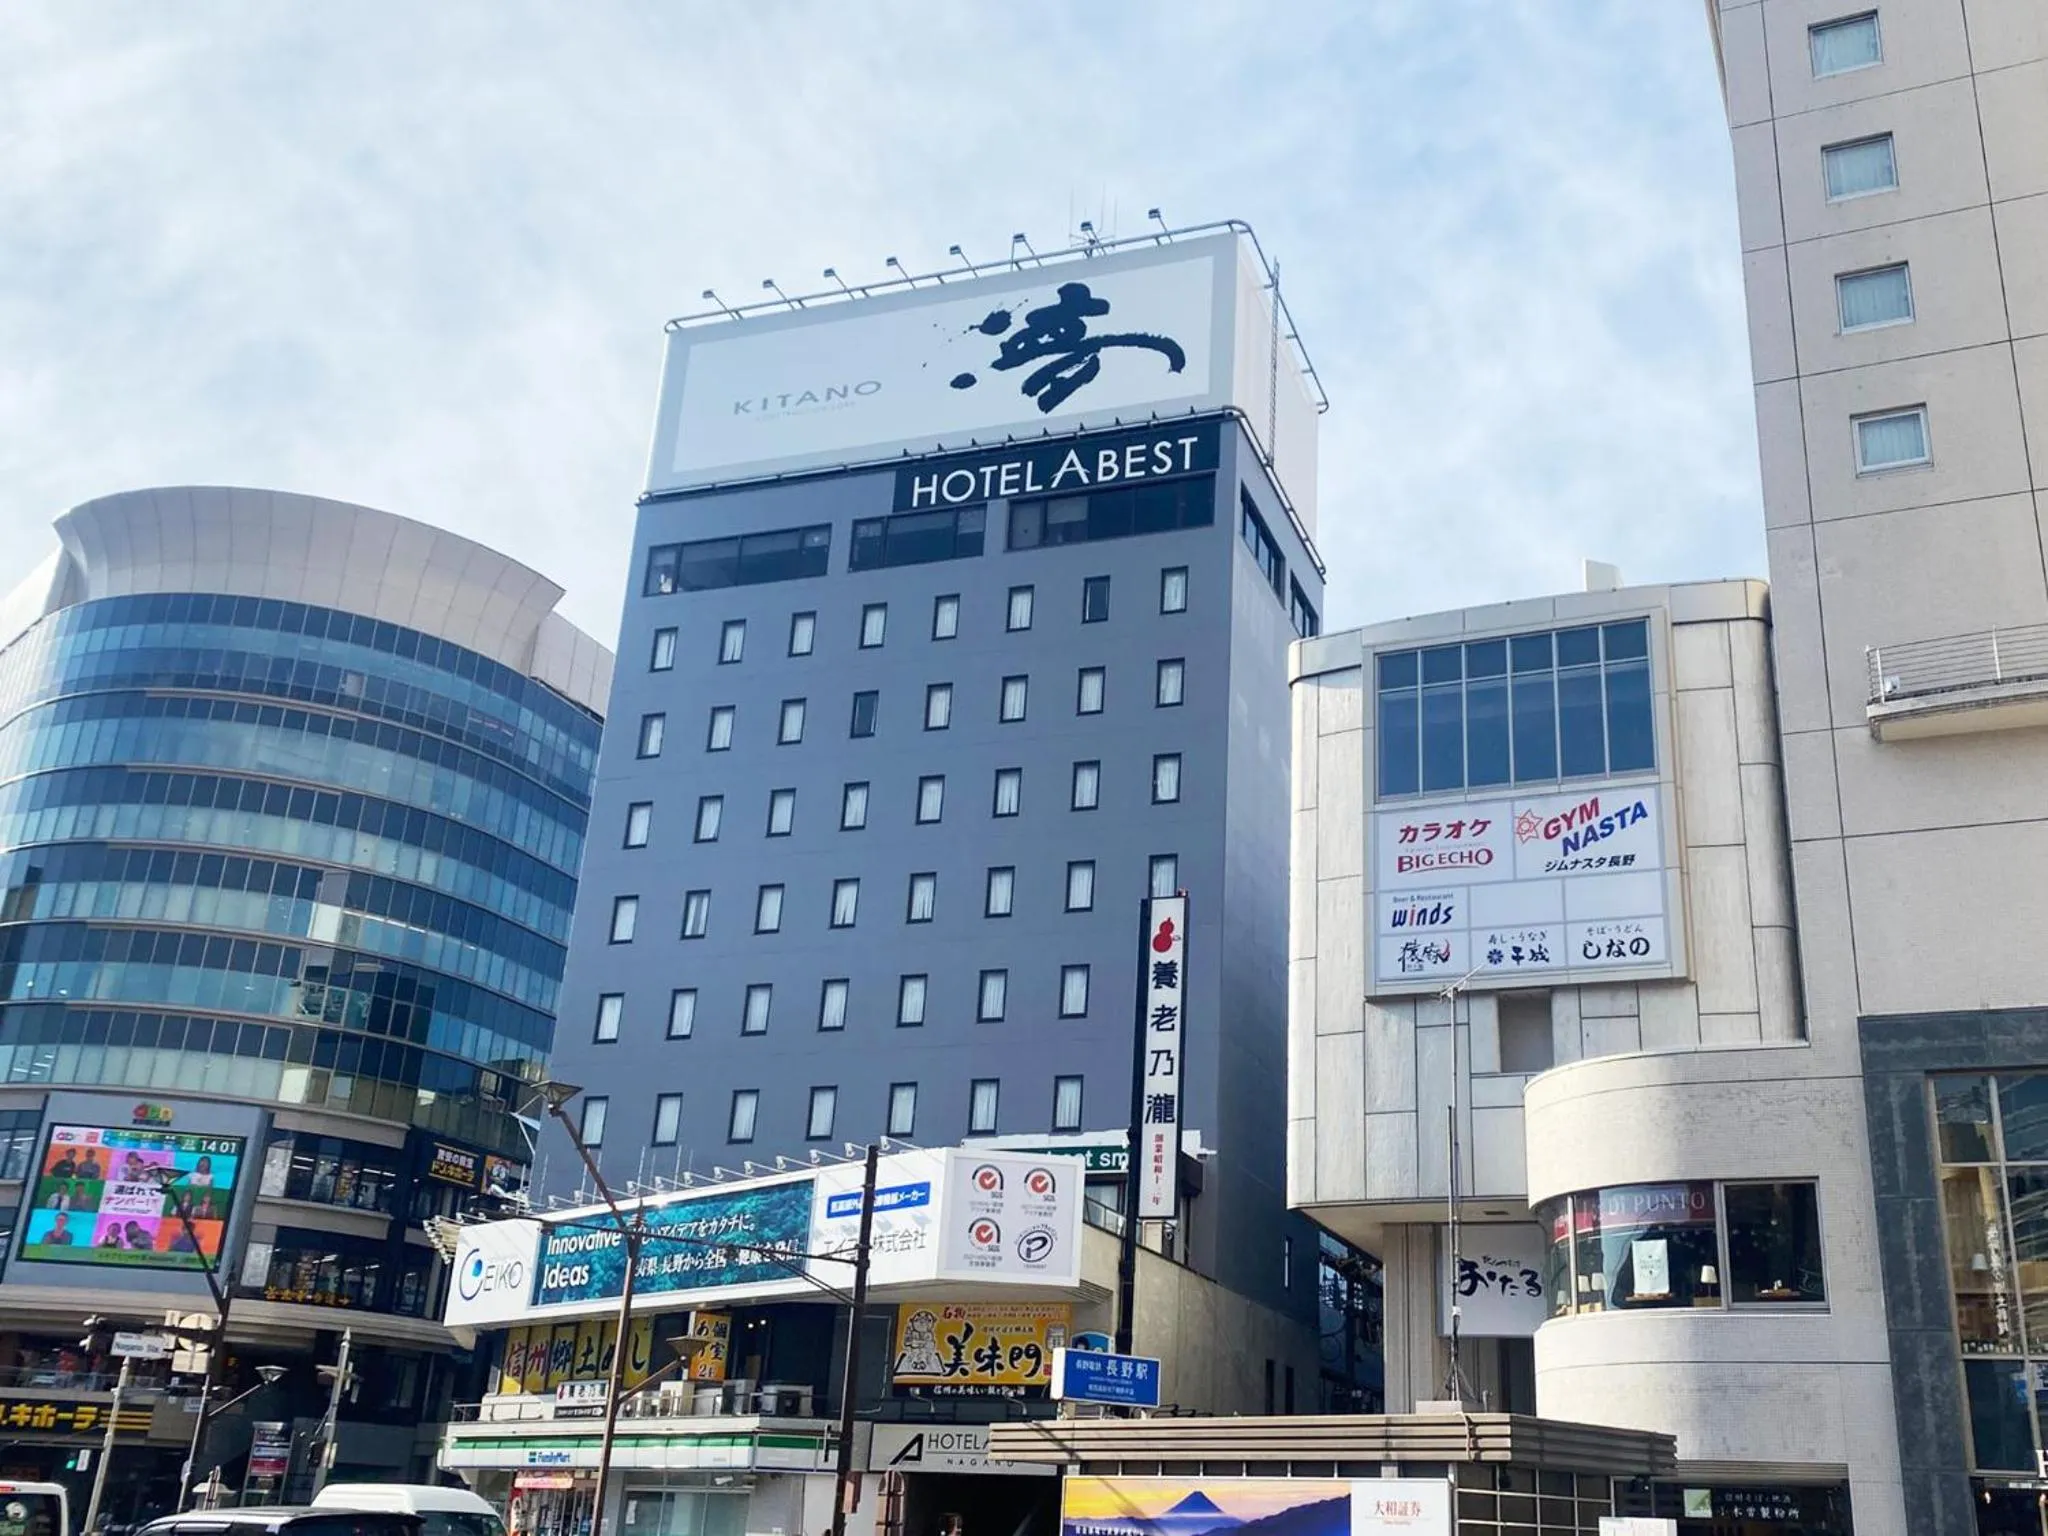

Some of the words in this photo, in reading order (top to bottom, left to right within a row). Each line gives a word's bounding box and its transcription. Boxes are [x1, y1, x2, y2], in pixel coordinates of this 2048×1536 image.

[733, 380, 882, 415] KITANO
[911, 460, 1043, 508] HOTEL
[1398, 818, 1492, 844] カラオケ
[1543, 796, 1600, 840] GYM
[1561, 800, 1649, 858] NASTA
[1544, 853, 1636, 872] ジムナスタ長野
[1391, 901, 1455, 928] winds
[1582, 936, 1651, 960] しなの
[1144, 960, 1179, 1126] 養老乃瀧
[1633, 1191, 1706, 1213] PUNTO
[547, 1230, 622, 1256] Innovative
[542, 1262, 590, 1290] Ideas
[1106, 1359, 1149, 1380] 長野駅
[927, 1433, 980, 1450] HOTEL
